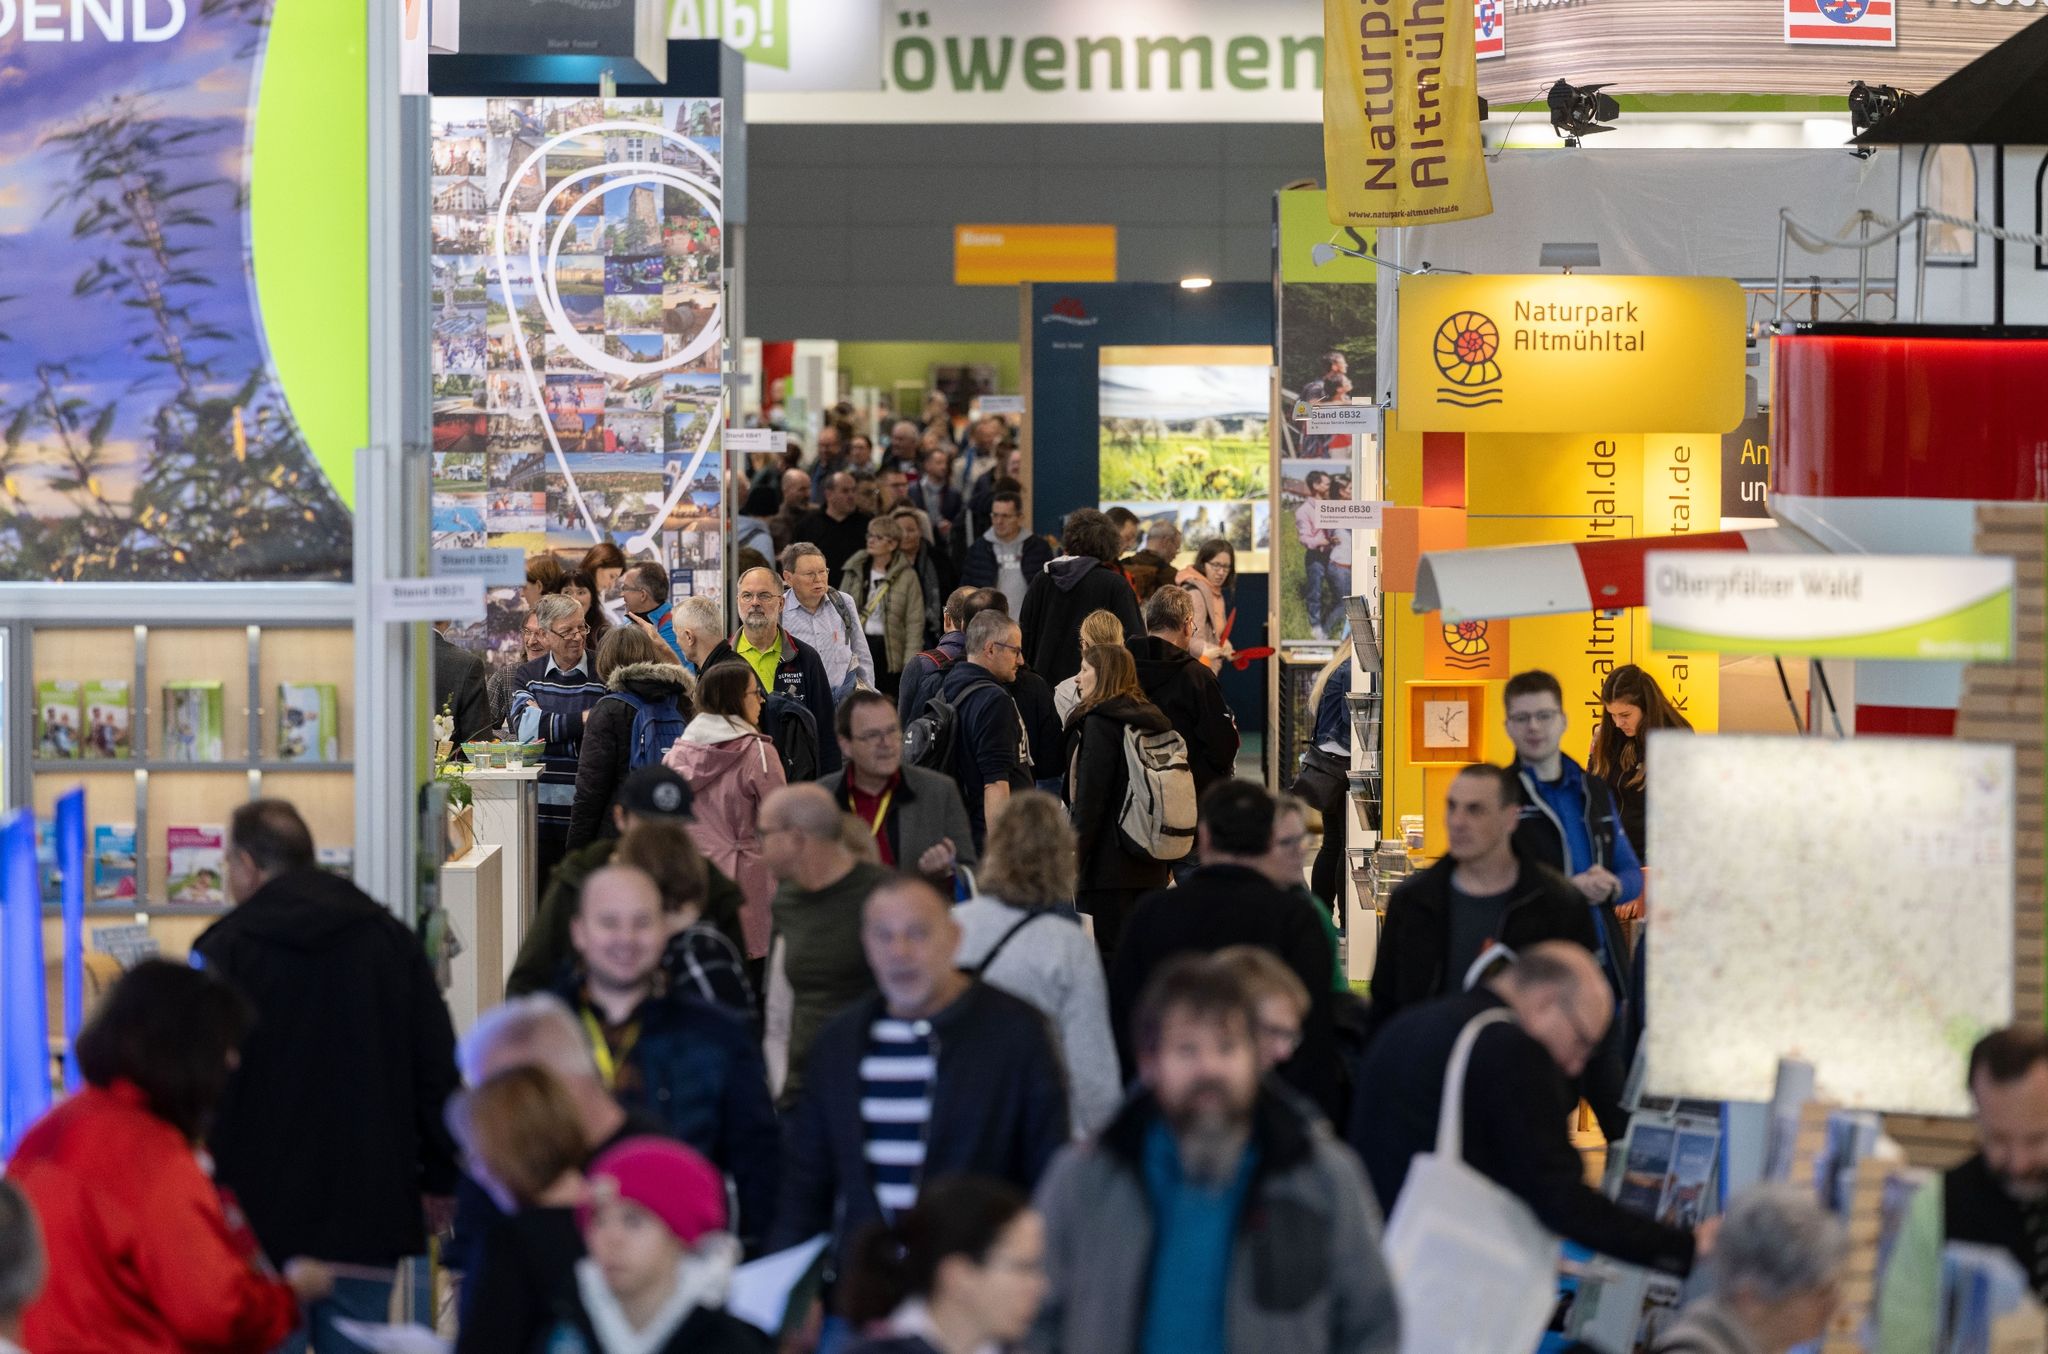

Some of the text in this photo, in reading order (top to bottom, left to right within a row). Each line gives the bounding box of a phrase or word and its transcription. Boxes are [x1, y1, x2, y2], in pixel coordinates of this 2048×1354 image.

[879, 11, 1324, 92] öwenmen
[1360, 0, 1400, 190] Naturp
[1514, 300, 1638, 327] Naturpark
[1514, 329, 1645, 352] Altmühltal
[1312, 411, 1337, 420] Stand
[1339, 410, 1361, 419] 6B32
[1320, 504, 1371, 513] Stand 6B30
[1799, 569, 1864, 600] Wald
